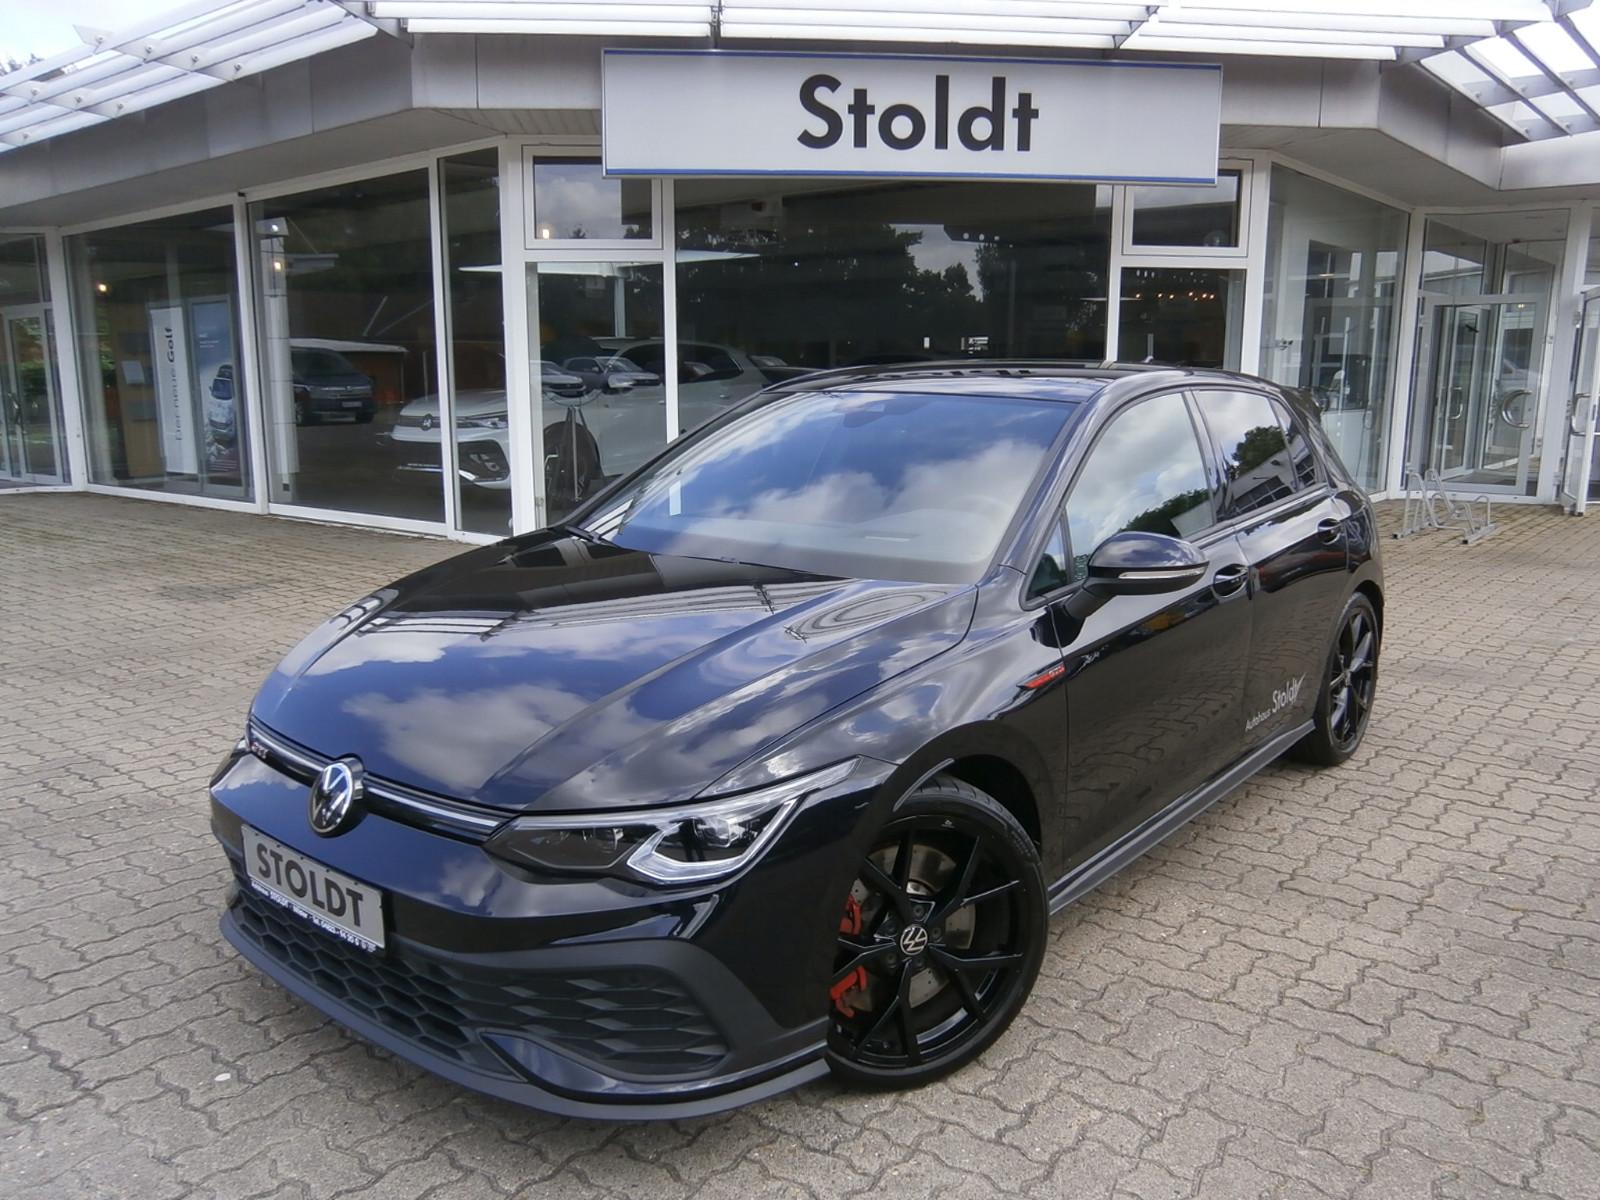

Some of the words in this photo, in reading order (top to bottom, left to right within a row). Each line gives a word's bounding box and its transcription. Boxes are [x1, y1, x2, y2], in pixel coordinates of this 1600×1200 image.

[797, 74, 1039, 152] Stoldt
[164, 327, 176, 363] Golf
[256, 842, 364, 928] STOLDT
